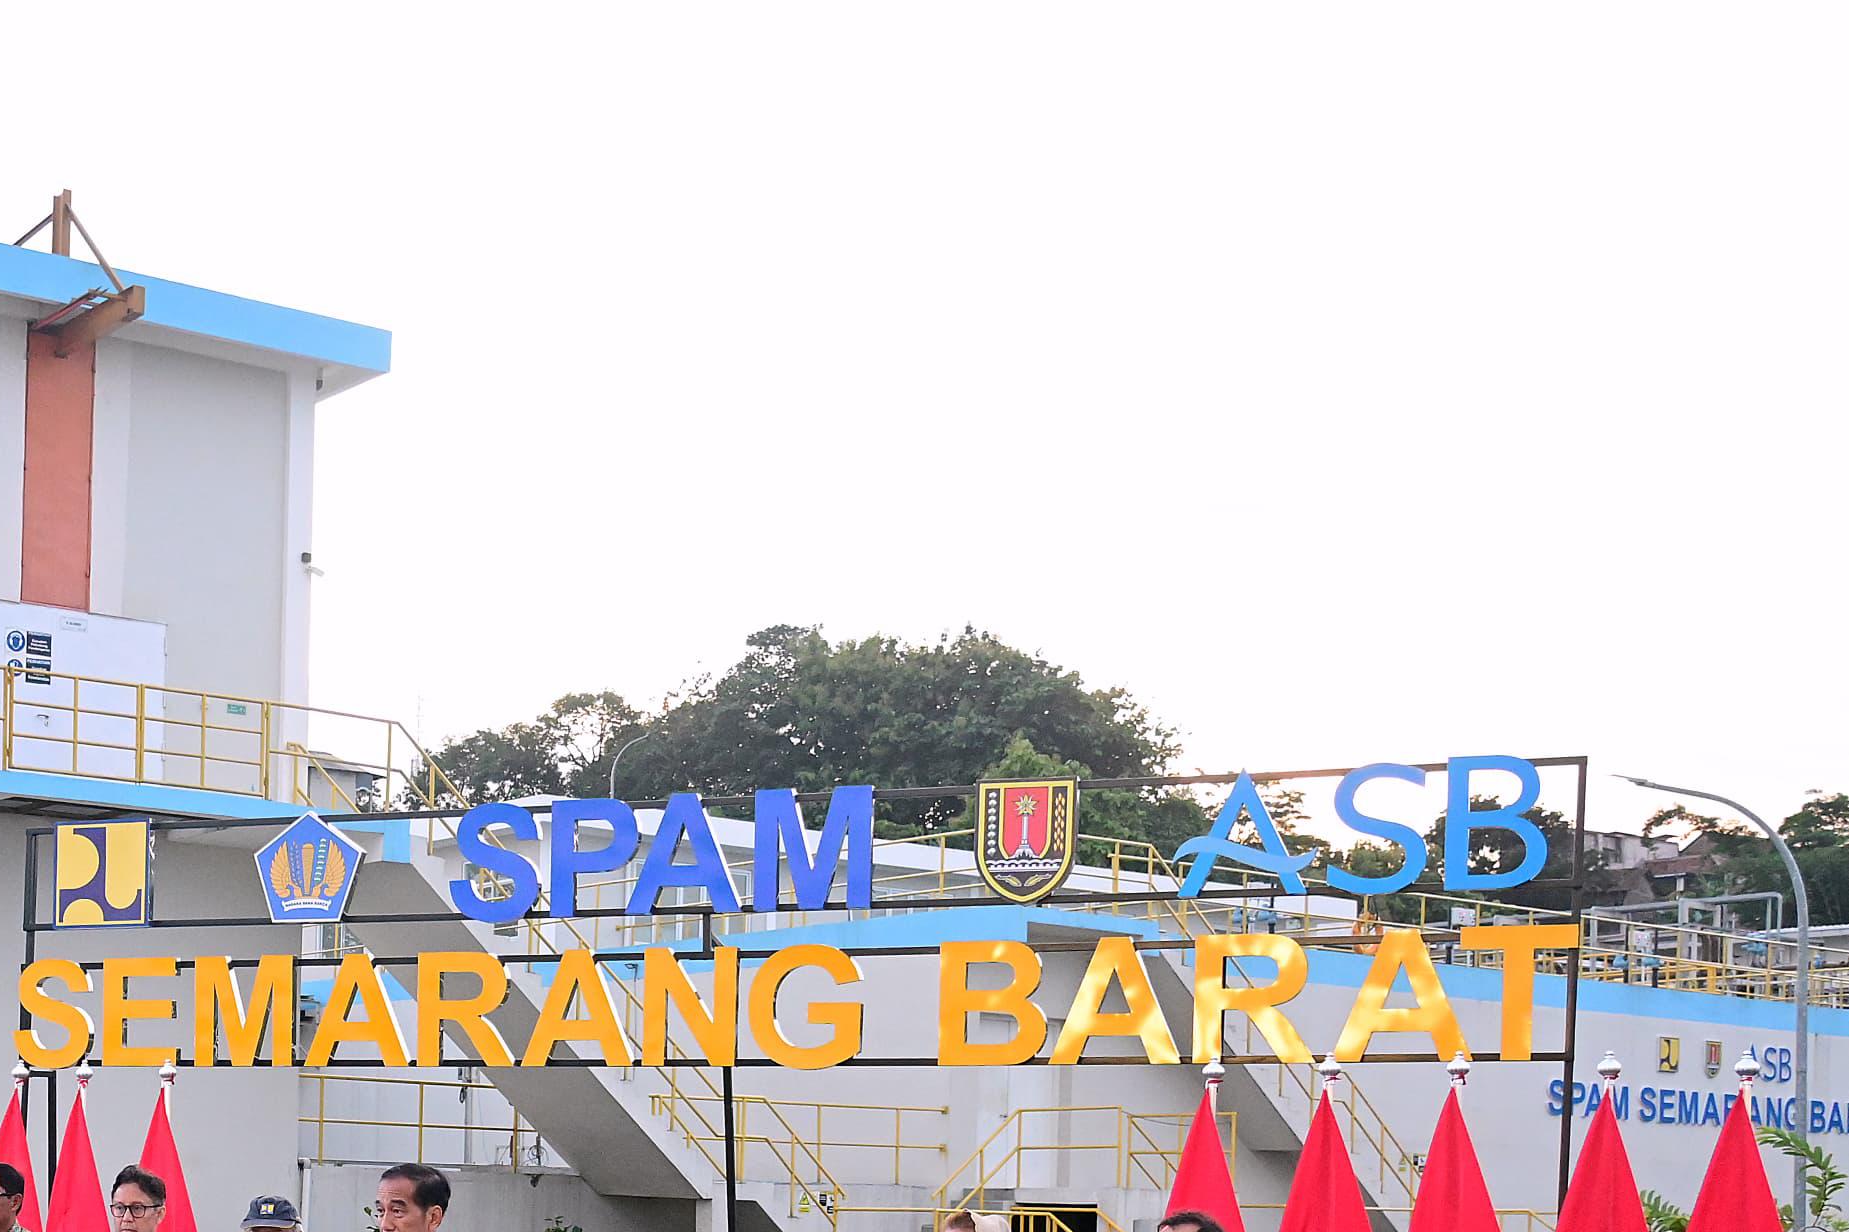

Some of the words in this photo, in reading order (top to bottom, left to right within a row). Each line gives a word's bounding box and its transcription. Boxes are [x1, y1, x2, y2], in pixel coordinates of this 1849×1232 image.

[450, 786, 874, 924] SPAM
[1173, 755, 1548, 898] ASB
[14, 943, 864, 1069] SEMARANG
[938, 924, 1580, 1066] BARAT
[1548, 1079, 1629, 1121] SPAM
[1809, 1099, 1849, 1134] BA
